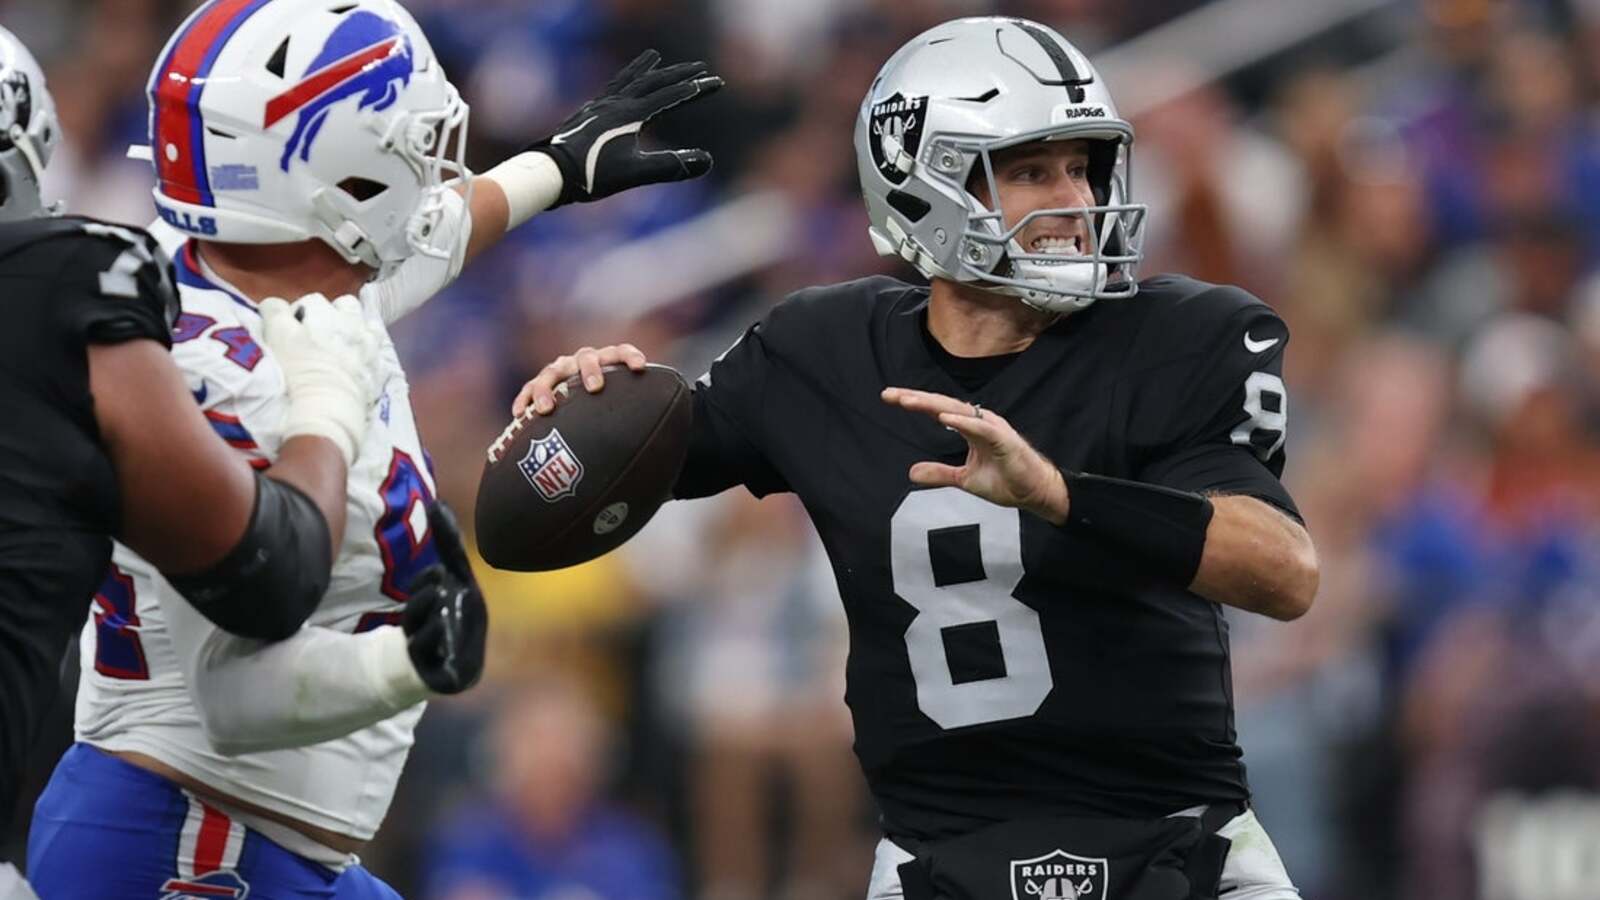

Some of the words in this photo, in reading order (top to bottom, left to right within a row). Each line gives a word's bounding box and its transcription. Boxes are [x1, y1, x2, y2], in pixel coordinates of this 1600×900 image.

[873, 99, 921, 116] RAIDERS
[1230, 371, 1288, 462] 8
[534, 456, 578, 496] NFL
[890, 486, 1054, 730] 8
[1021, 864, 1097, 877] RAIDERS
